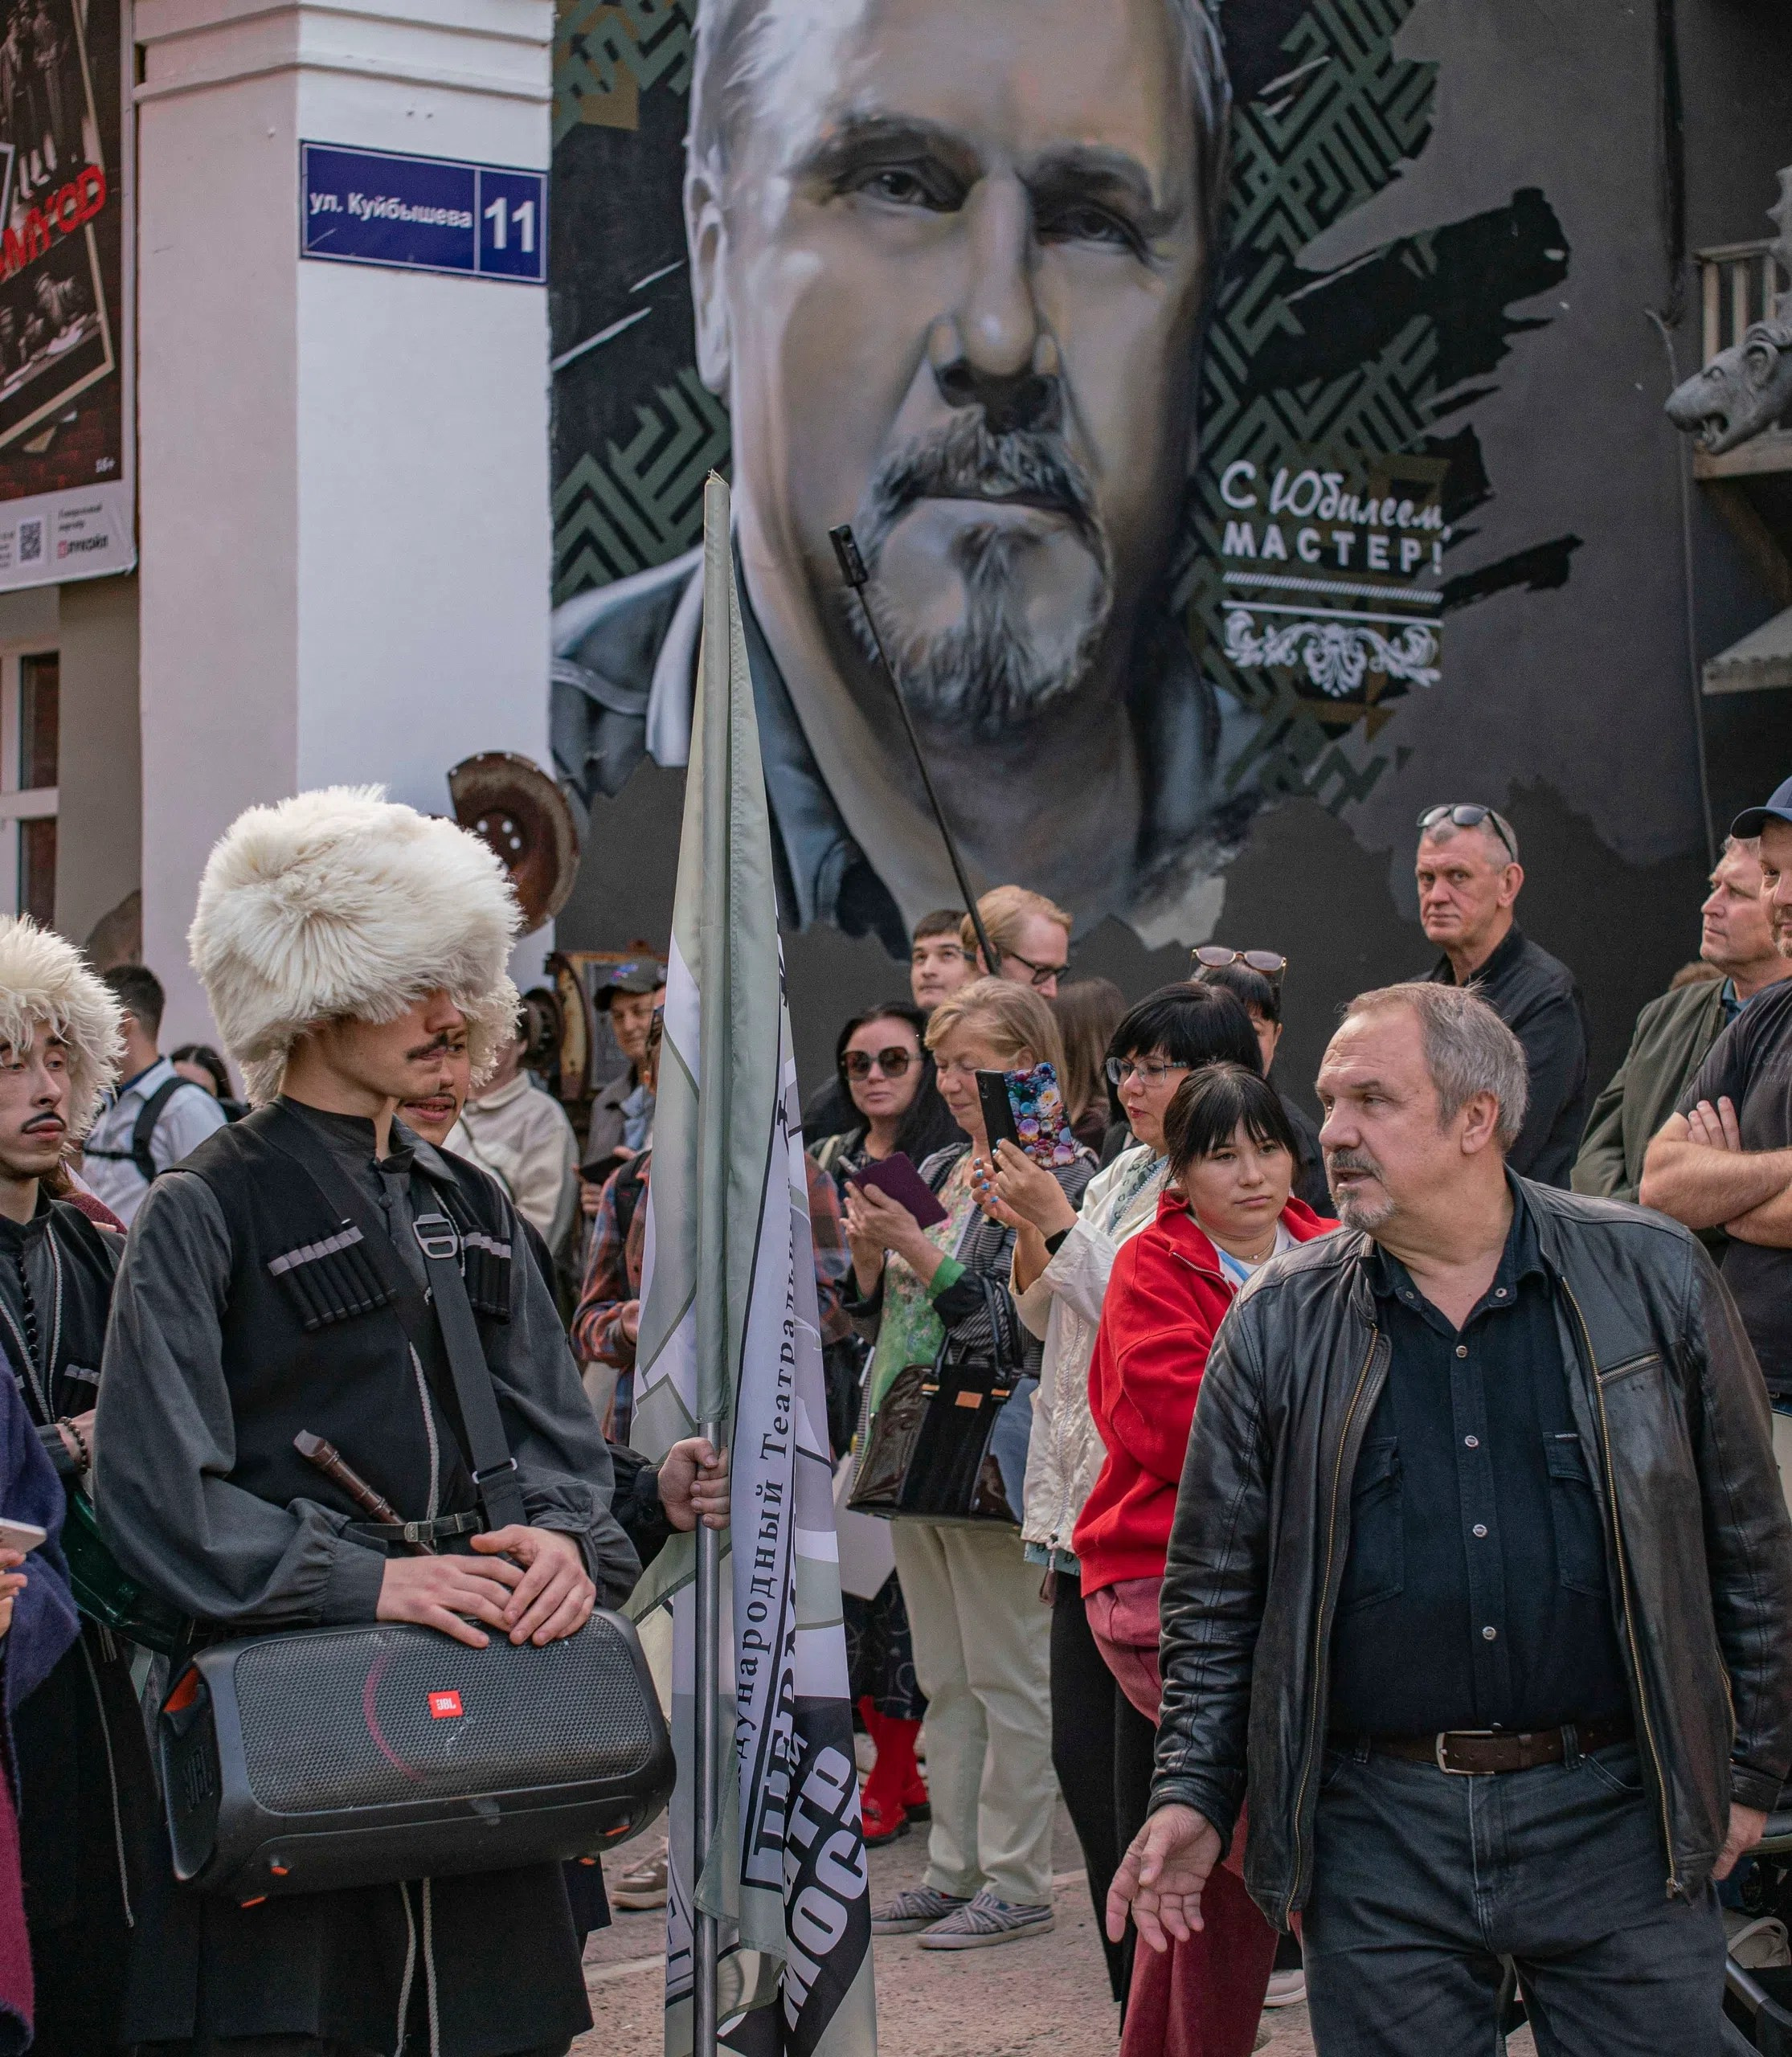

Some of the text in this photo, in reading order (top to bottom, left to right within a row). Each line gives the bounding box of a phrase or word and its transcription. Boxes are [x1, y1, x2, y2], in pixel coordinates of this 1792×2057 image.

[309, 191, 473, 228] ул. Куйбышева
[485, 197, 534, 253] 11
[1220, 460, 1257, 509] С
[1222, 520, 1442, 575] МАСТЕР!
[736, 1478, 784, 1764] дународный
